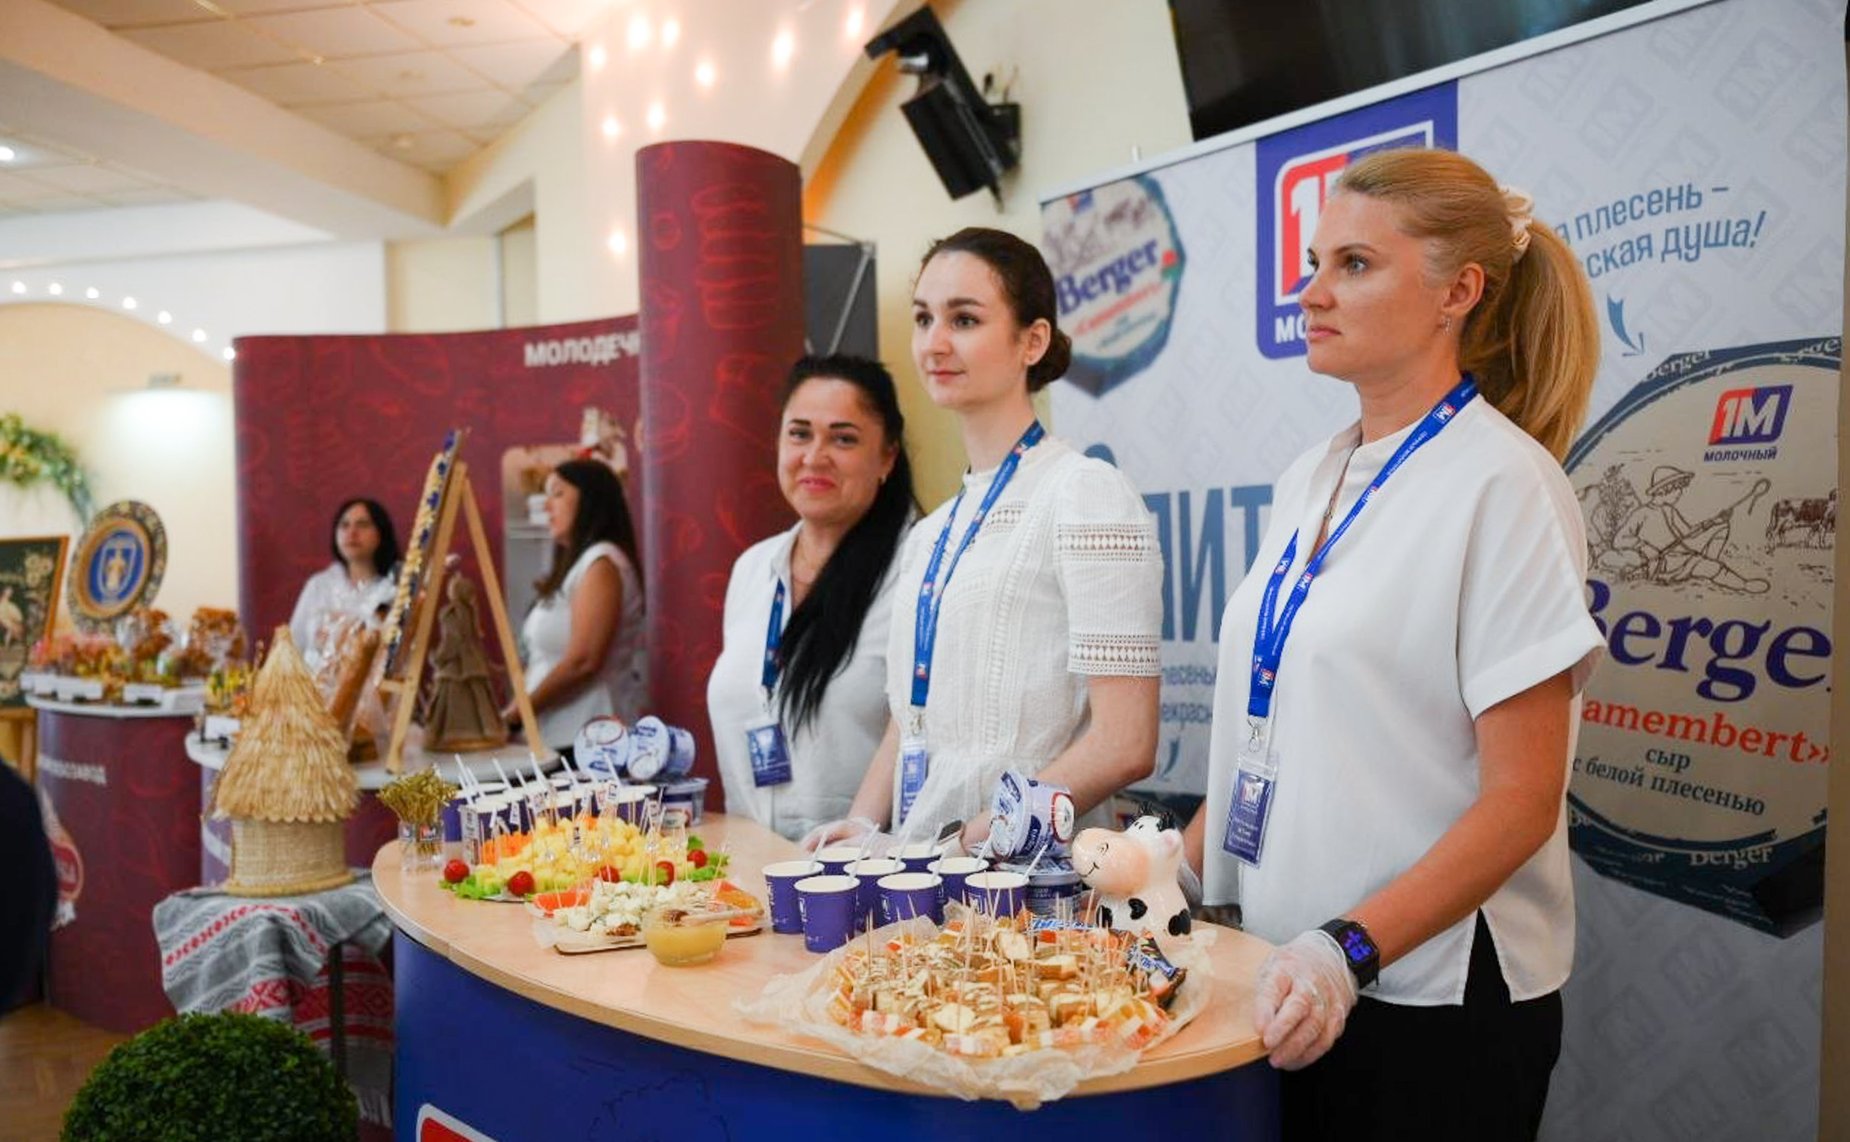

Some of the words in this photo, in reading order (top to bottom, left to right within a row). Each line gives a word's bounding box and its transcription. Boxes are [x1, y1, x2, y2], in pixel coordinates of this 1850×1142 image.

[1554, 221, 1571, 246] я
[1575, 182, 1703, 241] плесень
[1580, 232, 1654, 279] ская
[1660, 210, 1767, 263] душа!
[1055, 239, 1158, 316] Berger
[523, 330, 641, 367] МОЛОДЕЧ
[1703, 446, 1778, 463] МОЛОЧНЫЙ
[1581, 698, 1831, 765] amembert»
[1645, 748, 1691, 774] сыр
[1586, 755, 1643, 788] белой
[1650, 773, 1767, 818] плесенью
